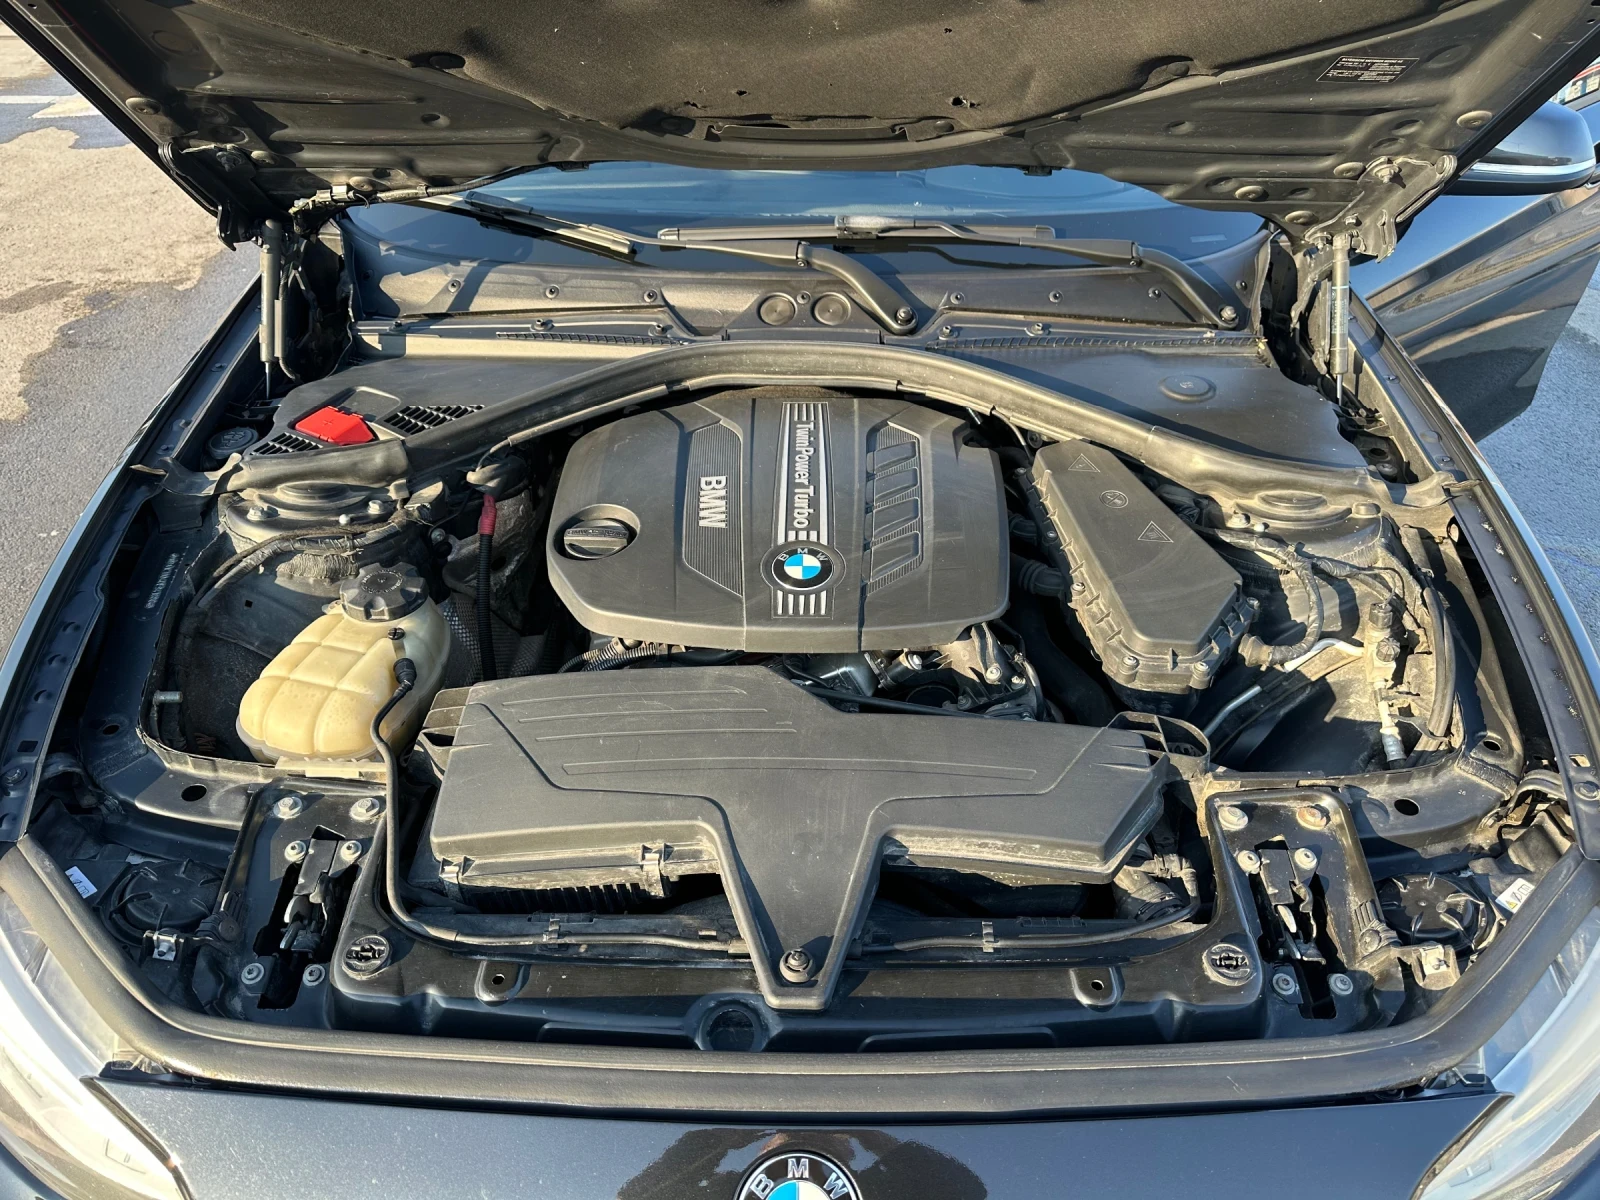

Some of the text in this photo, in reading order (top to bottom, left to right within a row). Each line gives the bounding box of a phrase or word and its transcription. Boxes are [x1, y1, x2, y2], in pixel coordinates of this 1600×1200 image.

[793, 422, 815, 529] TwinPower Turbo
[699, 475, 727, 528] BMW
[778, 547, 828, 562] BMW
[749, 1158, 849, 1200] BMW
